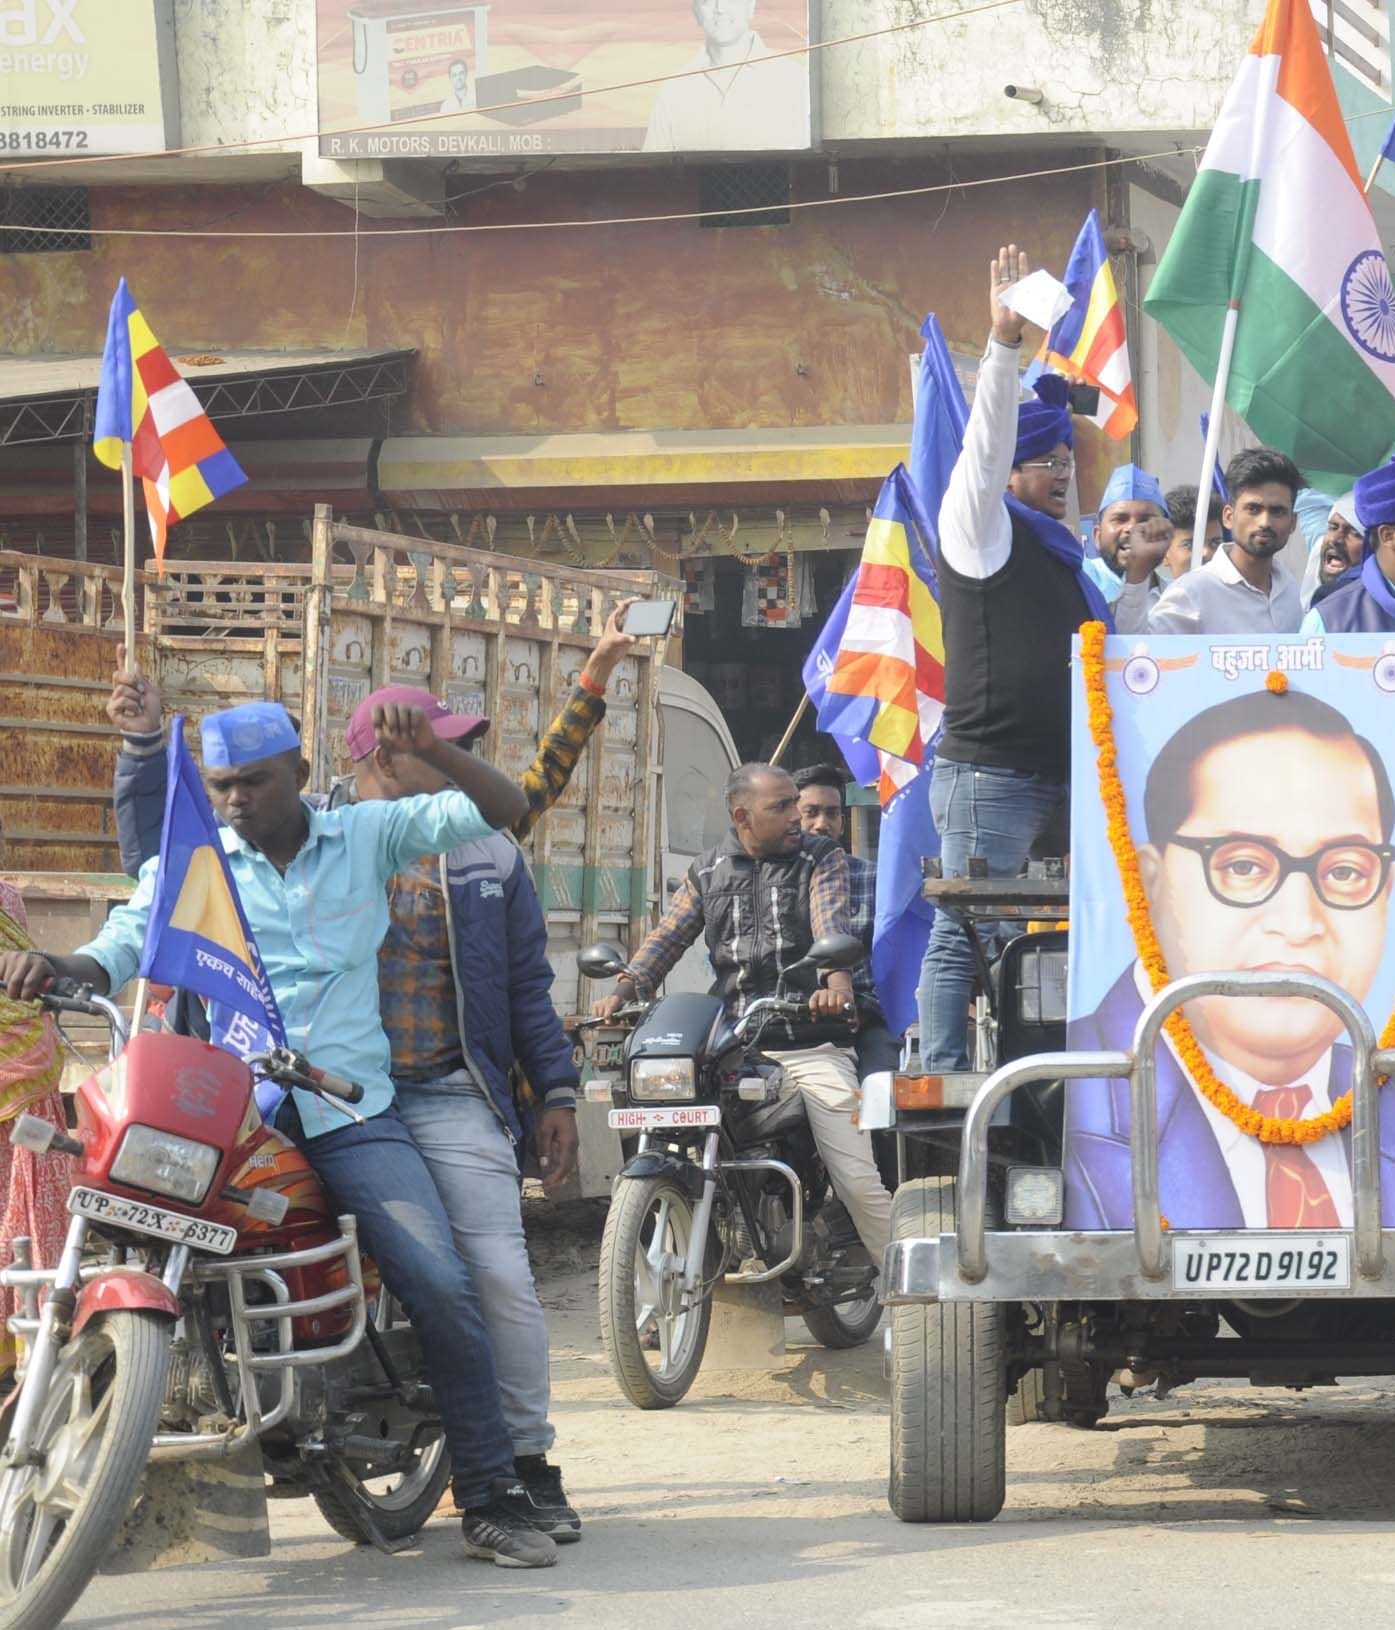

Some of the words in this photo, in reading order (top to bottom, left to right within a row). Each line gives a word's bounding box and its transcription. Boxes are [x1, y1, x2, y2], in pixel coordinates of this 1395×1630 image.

[0, 105, 35, 117] STRING
[38, 104, 84, 116] INVERTER
[92, 103, 145, 115] STABILIZER
[1210, 644, 1270, 680] बहुजन
[1276, 637, 1326, 671] आर्मी
[617, 1111, 643, 1125] HIGH
[672, 1111, 708, 1124] COURT
